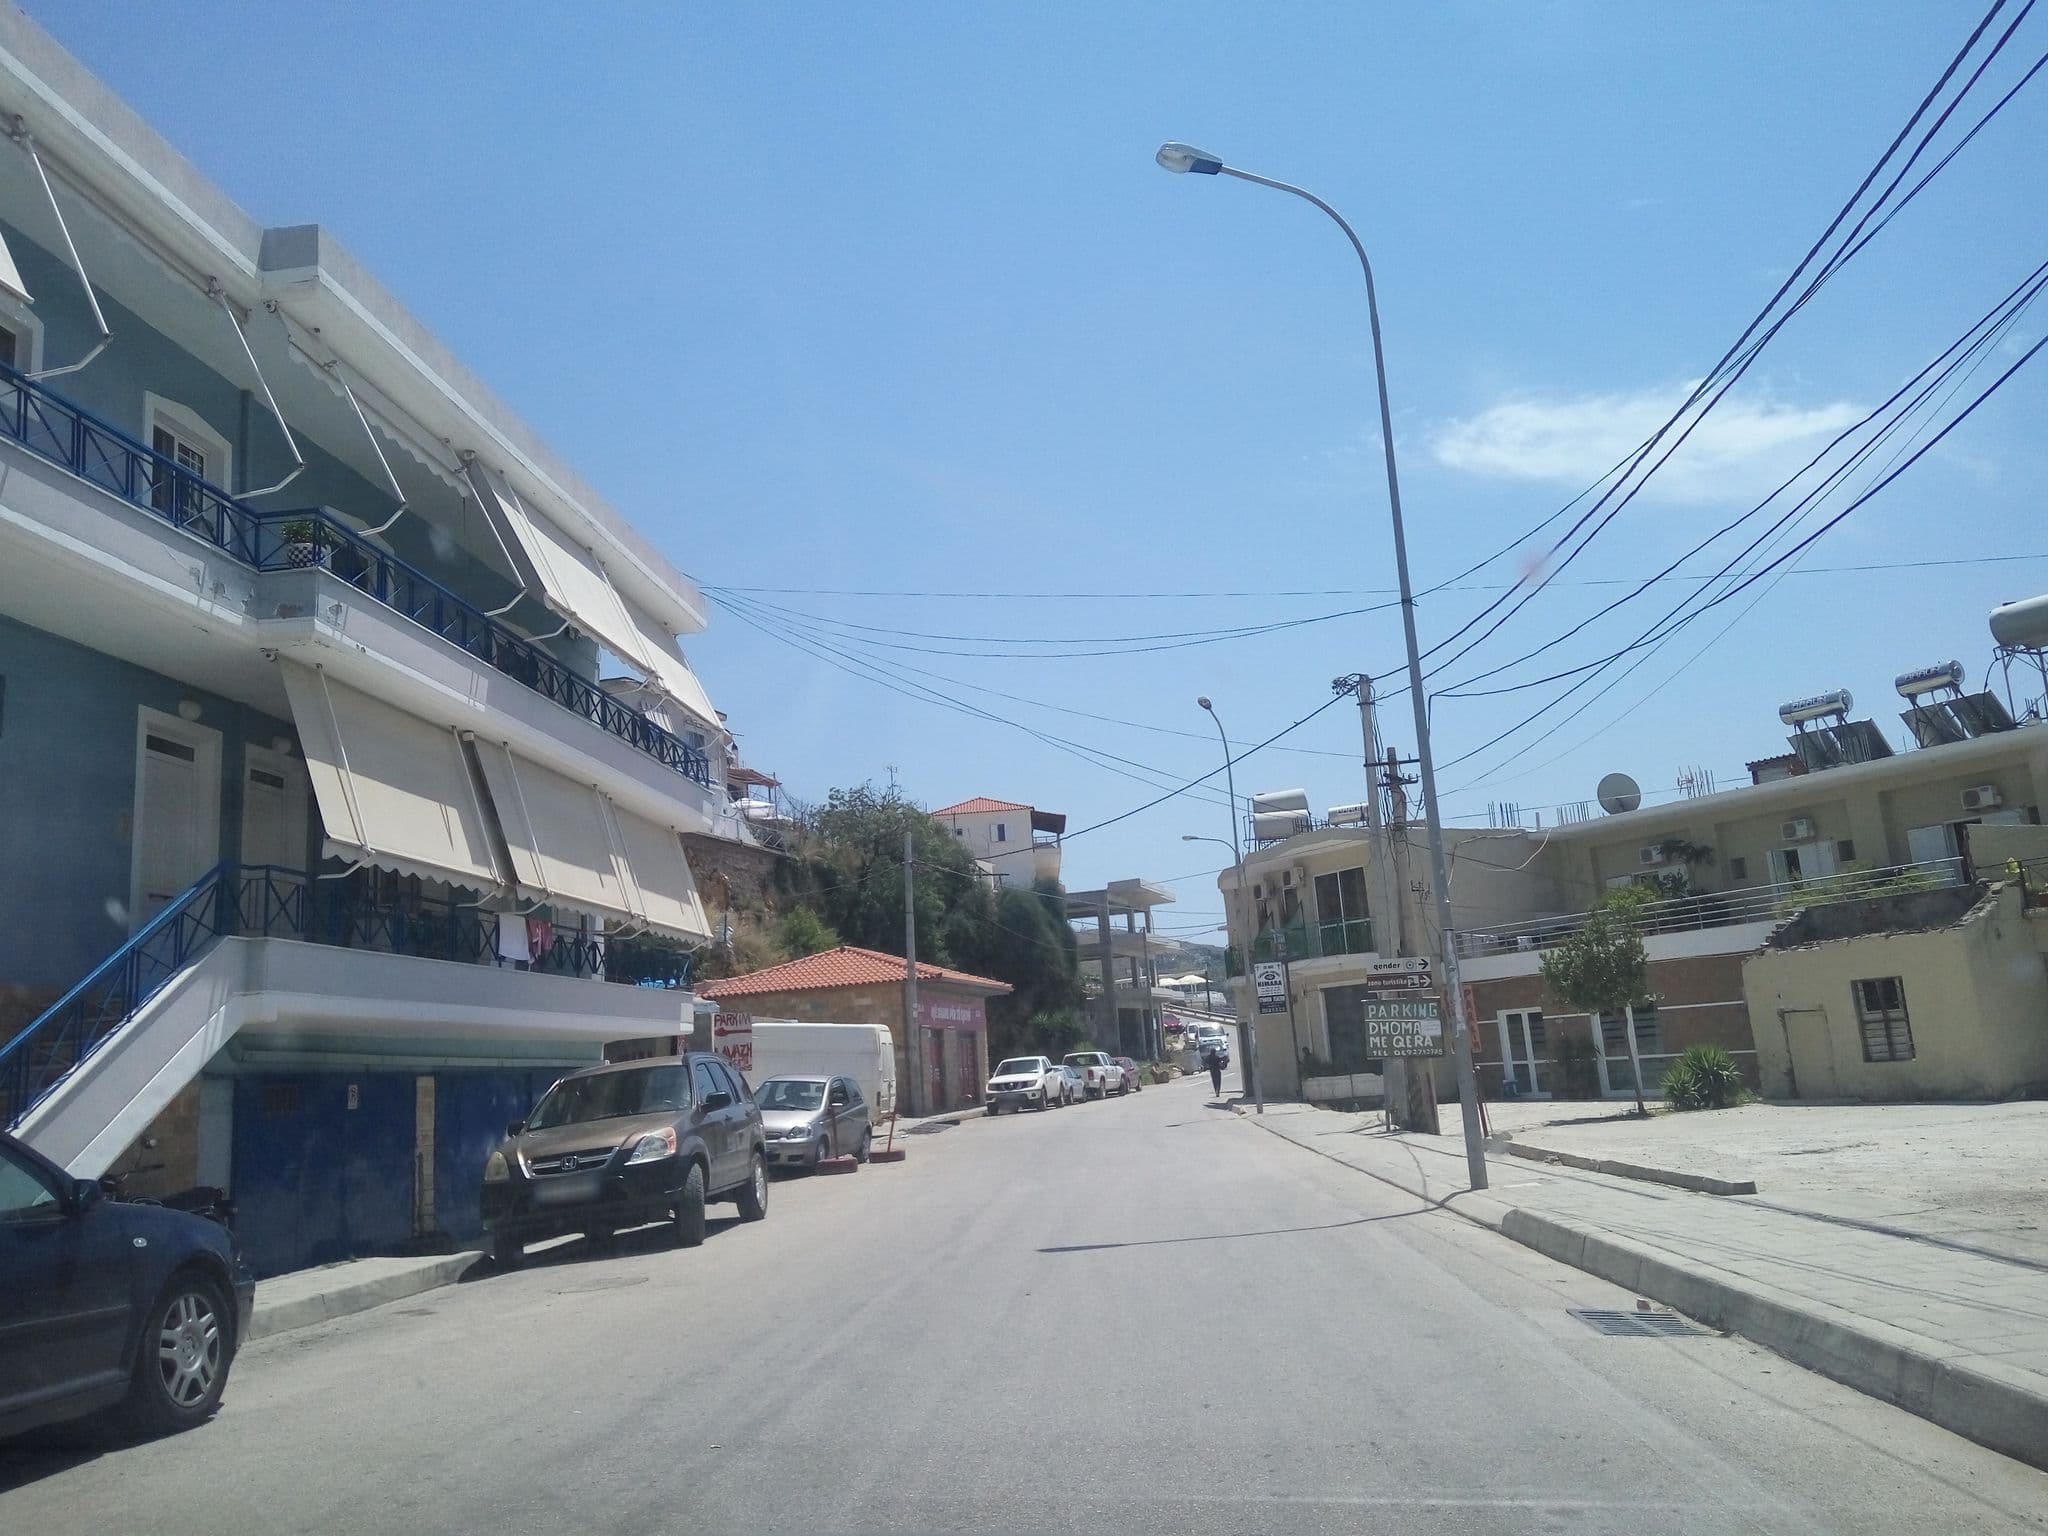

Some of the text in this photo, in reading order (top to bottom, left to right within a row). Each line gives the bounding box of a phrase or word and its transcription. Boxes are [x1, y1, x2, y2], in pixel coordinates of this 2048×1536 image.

[1368, 1002, 1438, 1018] PARKING
[1368, 1021, 1420, 1035] DHOMA
[1369, 1034, 1434, 1048] ME QERA
